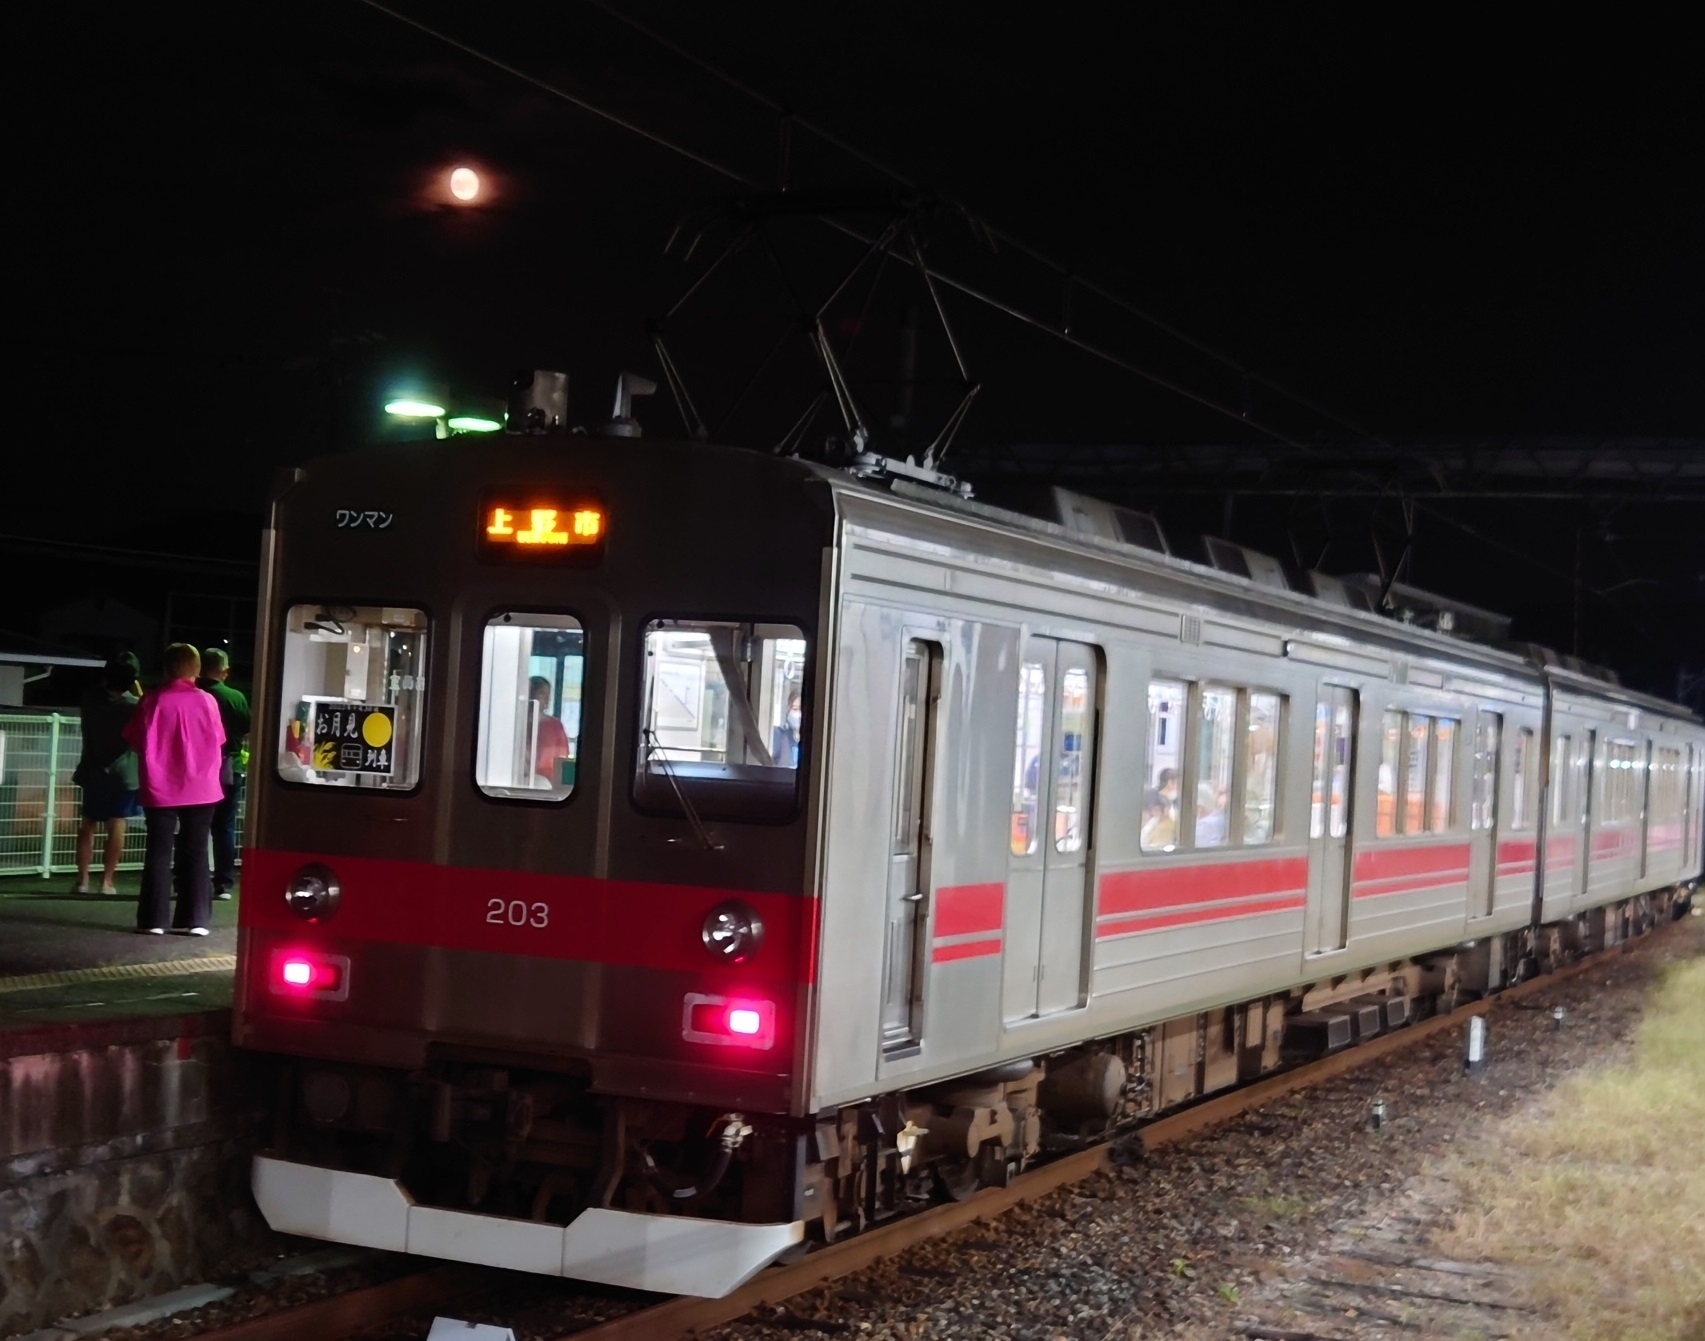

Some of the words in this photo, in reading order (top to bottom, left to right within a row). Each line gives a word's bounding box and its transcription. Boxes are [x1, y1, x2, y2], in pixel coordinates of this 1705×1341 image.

[336, 509, 393, 528] ワンマン
[316, 712, 358, 738] お月見
[364, 748, 389, 770] 列車
[486, 898, 549, 928] 203
